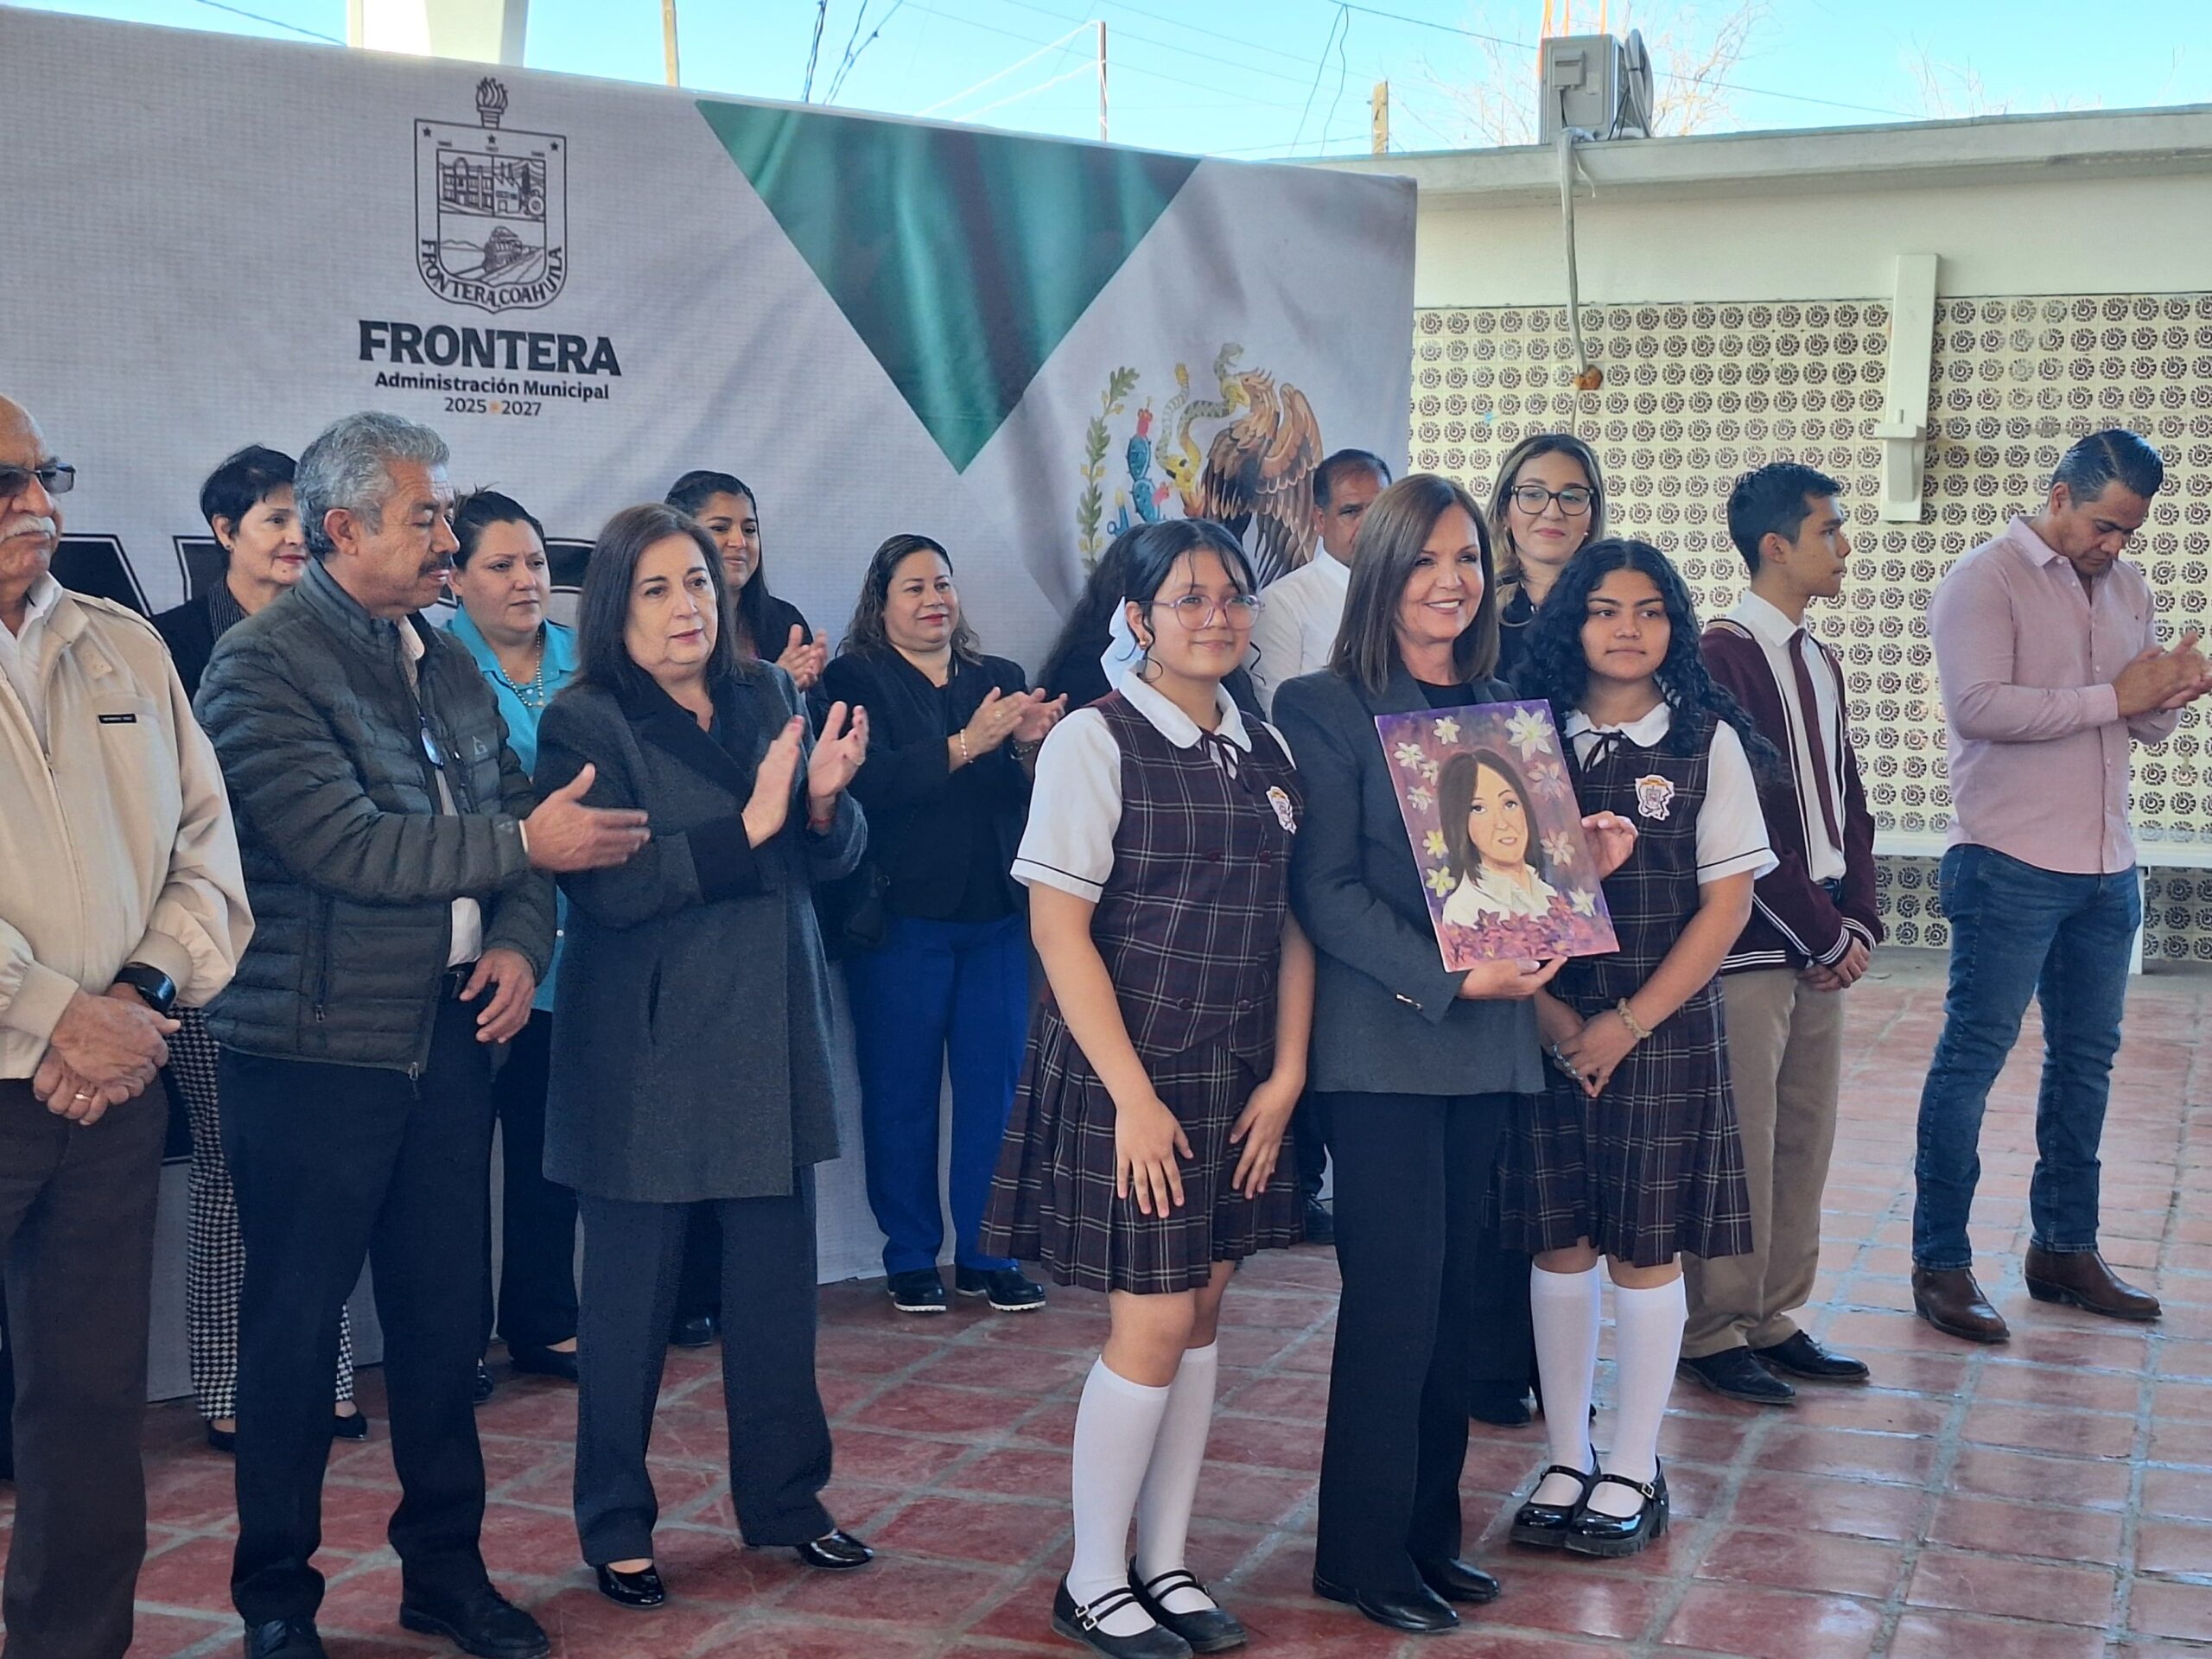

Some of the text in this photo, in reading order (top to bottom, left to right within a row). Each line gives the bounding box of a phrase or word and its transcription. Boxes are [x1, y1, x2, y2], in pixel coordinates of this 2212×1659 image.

[499, 246, 563, 305] COAHUILA
[359, 319, 622, 376] FRONTERA
[375, 371, 609, 403] Administración Municipal
[444, 397, 542, 416] 2025 2027
